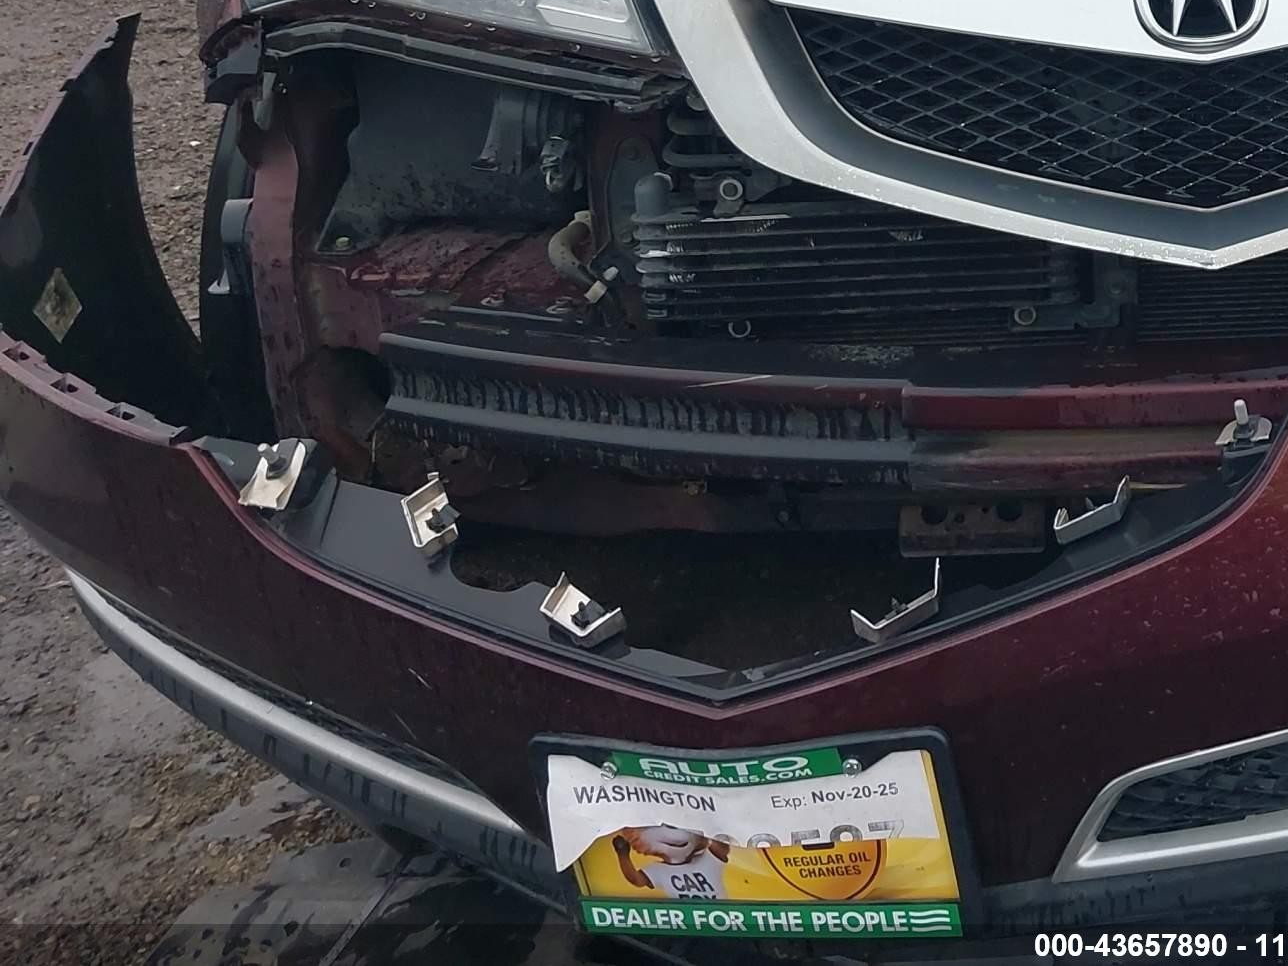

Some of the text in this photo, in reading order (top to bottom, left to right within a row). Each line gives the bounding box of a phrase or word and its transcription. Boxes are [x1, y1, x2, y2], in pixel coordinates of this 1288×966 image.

[638, 756, 809, 776] AUTO
[643, 768, 813, 784] CREDIT SALES.COM
[574, 782, 900, 812] WASHINGTON Exp: Nov-20-25
[783, 851, 872, 868] REGULAR OIL
[798, 865, 862, 879] CHANGES
[670, 872, 715, 893] CAR
[591, 907, 910, 933] DEALER FOR THE PEOPLE
